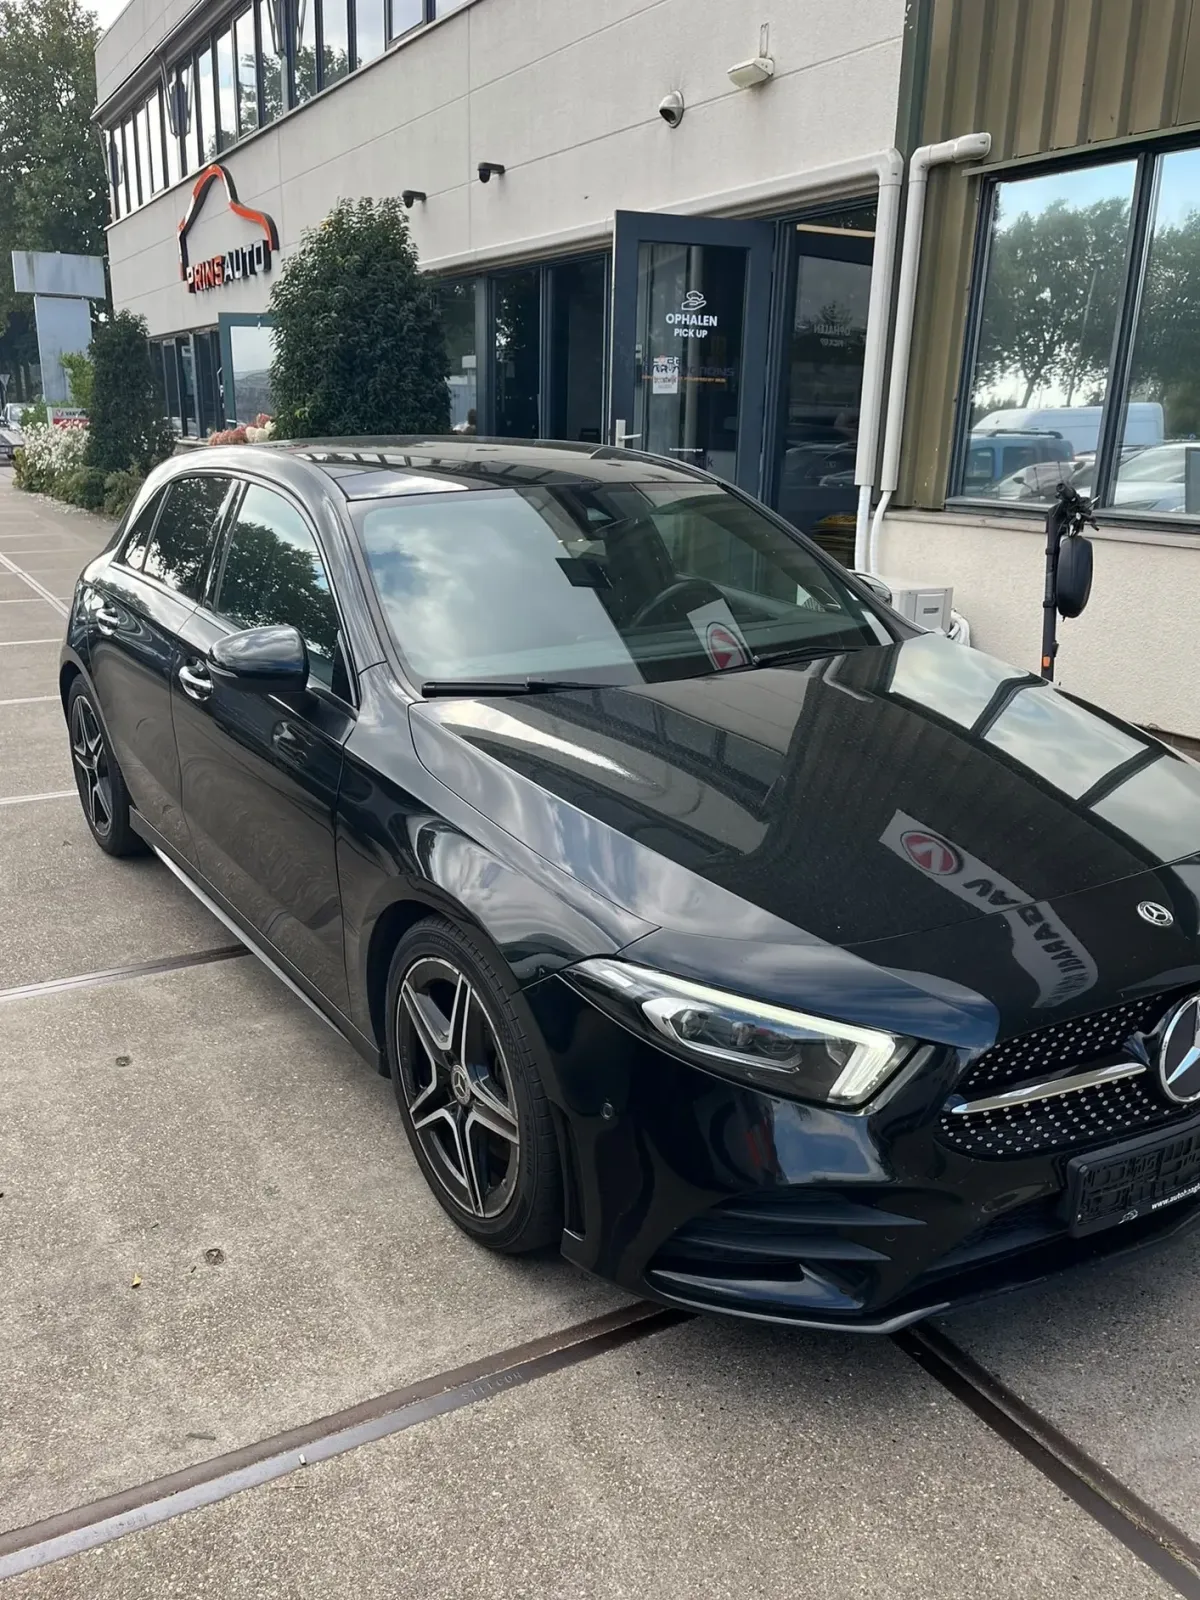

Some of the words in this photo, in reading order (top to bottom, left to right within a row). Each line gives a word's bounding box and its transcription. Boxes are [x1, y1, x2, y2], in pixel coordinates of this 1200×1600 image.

[186, 240, 270, 293] PRINSAUTO
[665, 313, 718, 327] OPHALEN
[674, 328, 695, 338] PICK
[696, 329, 708, 339] UP
